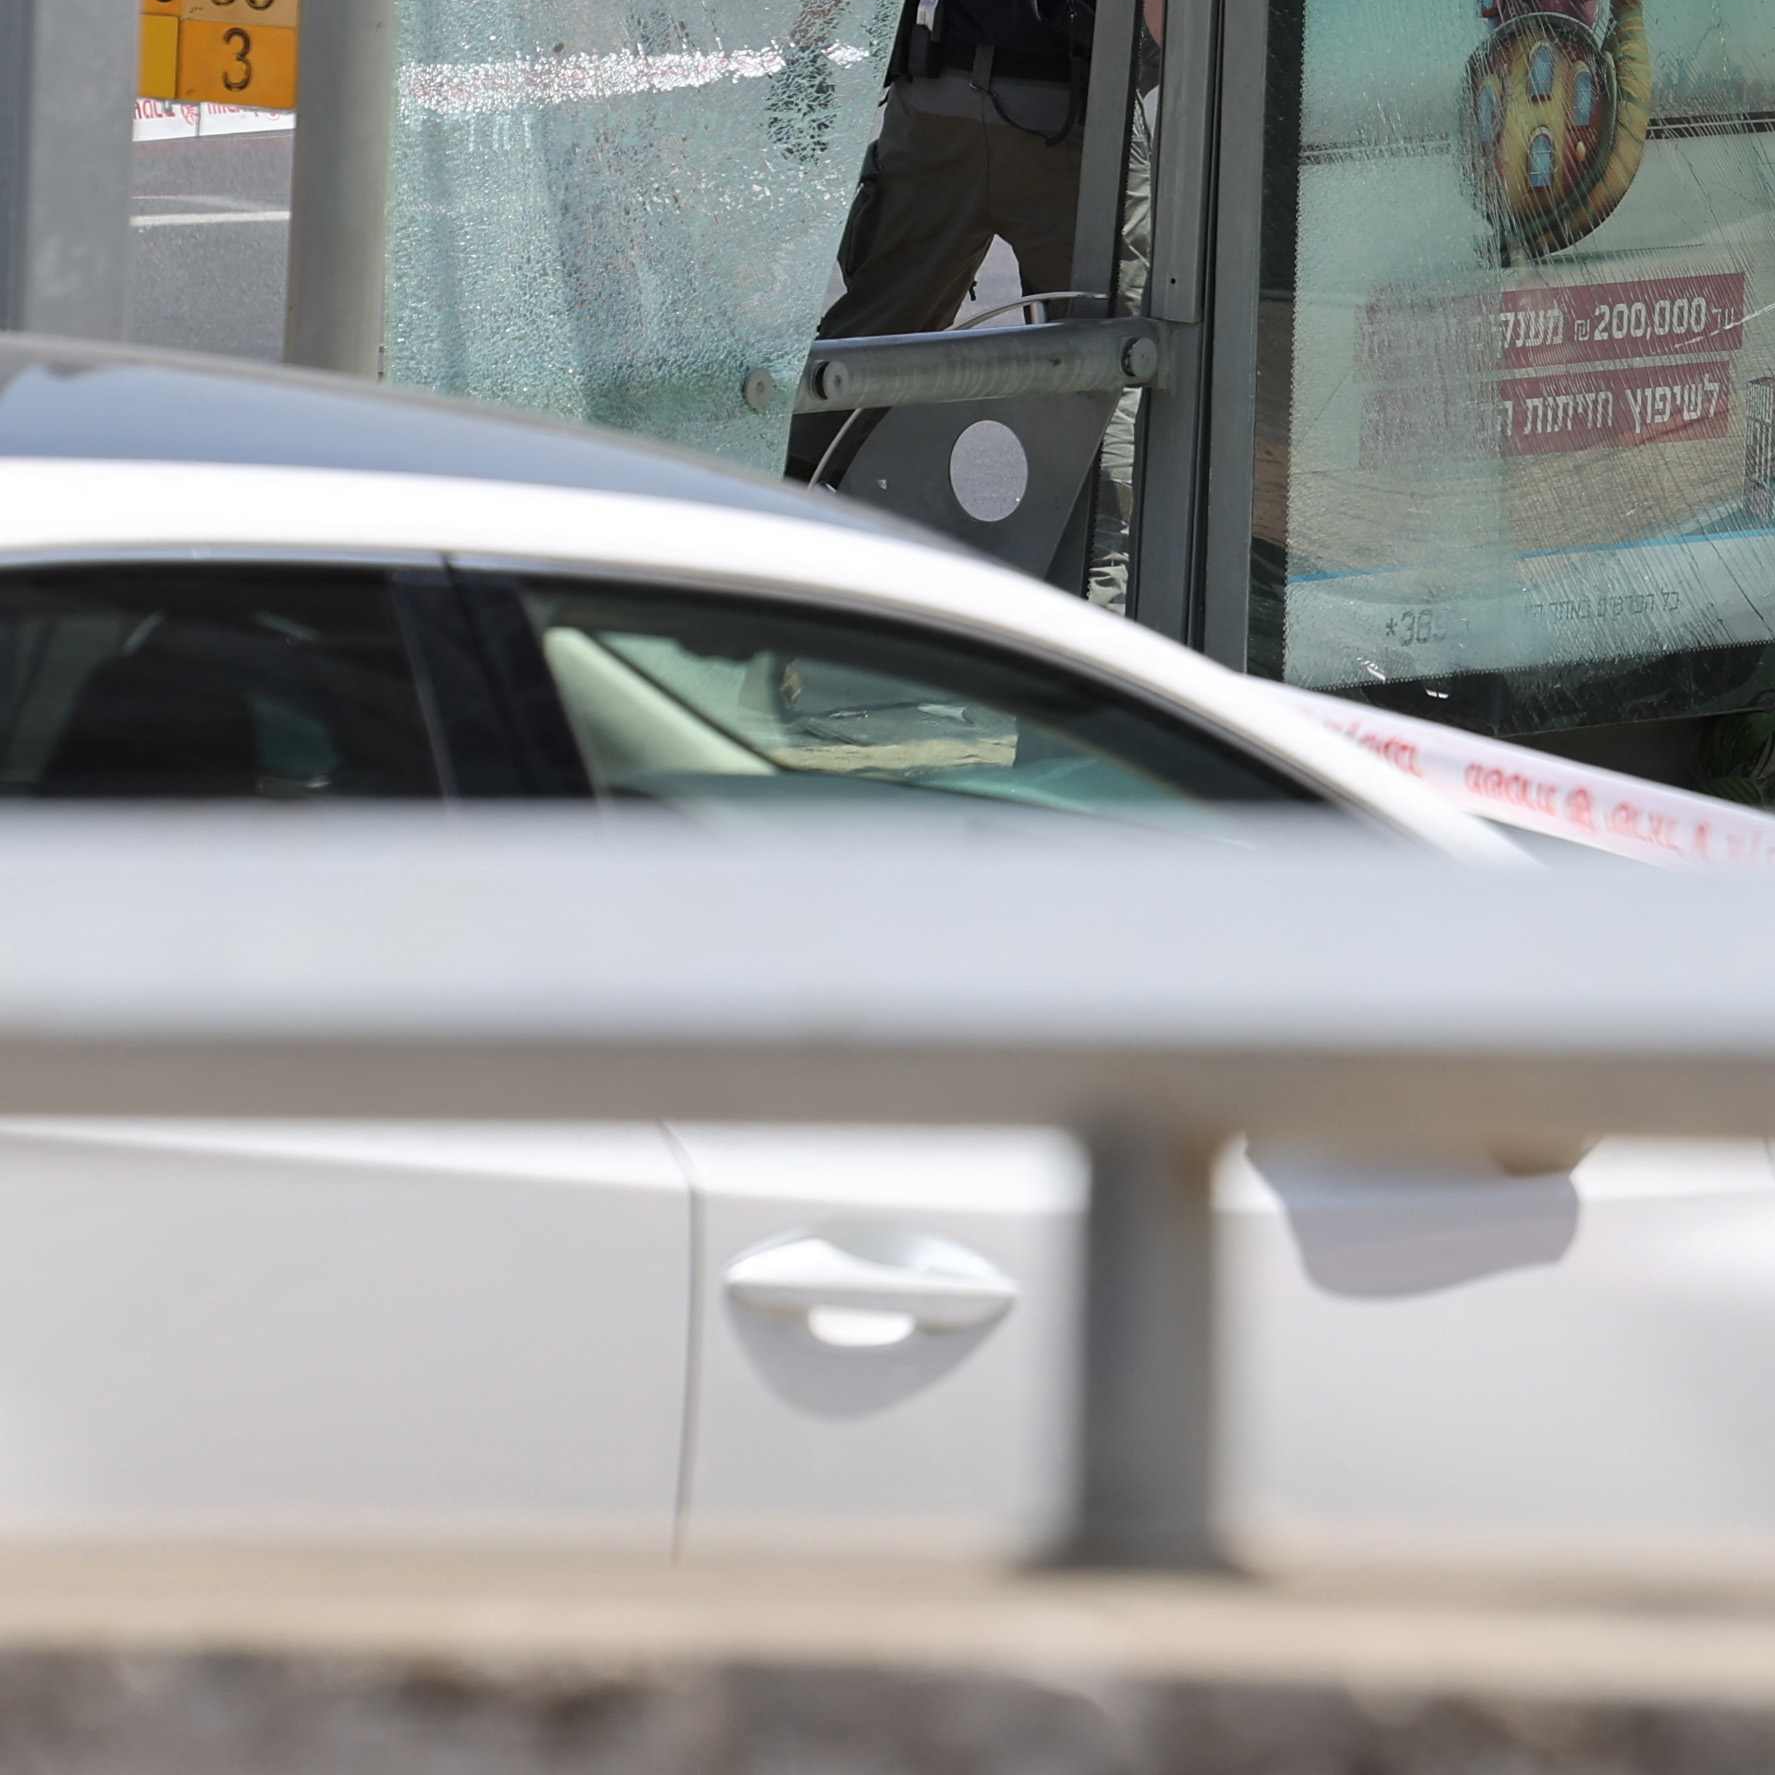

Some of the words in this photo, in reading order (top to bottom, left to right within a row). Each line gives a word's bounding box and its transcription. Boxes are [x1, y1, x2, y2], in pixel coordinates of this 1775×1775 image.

[221, 27, 252, 92] 3
[1595, 297, 1707, 342] 200,000
[1524, 390, 1614, 436] חזיתות
[1624, 374, 1720, 434] לשיפוץ
